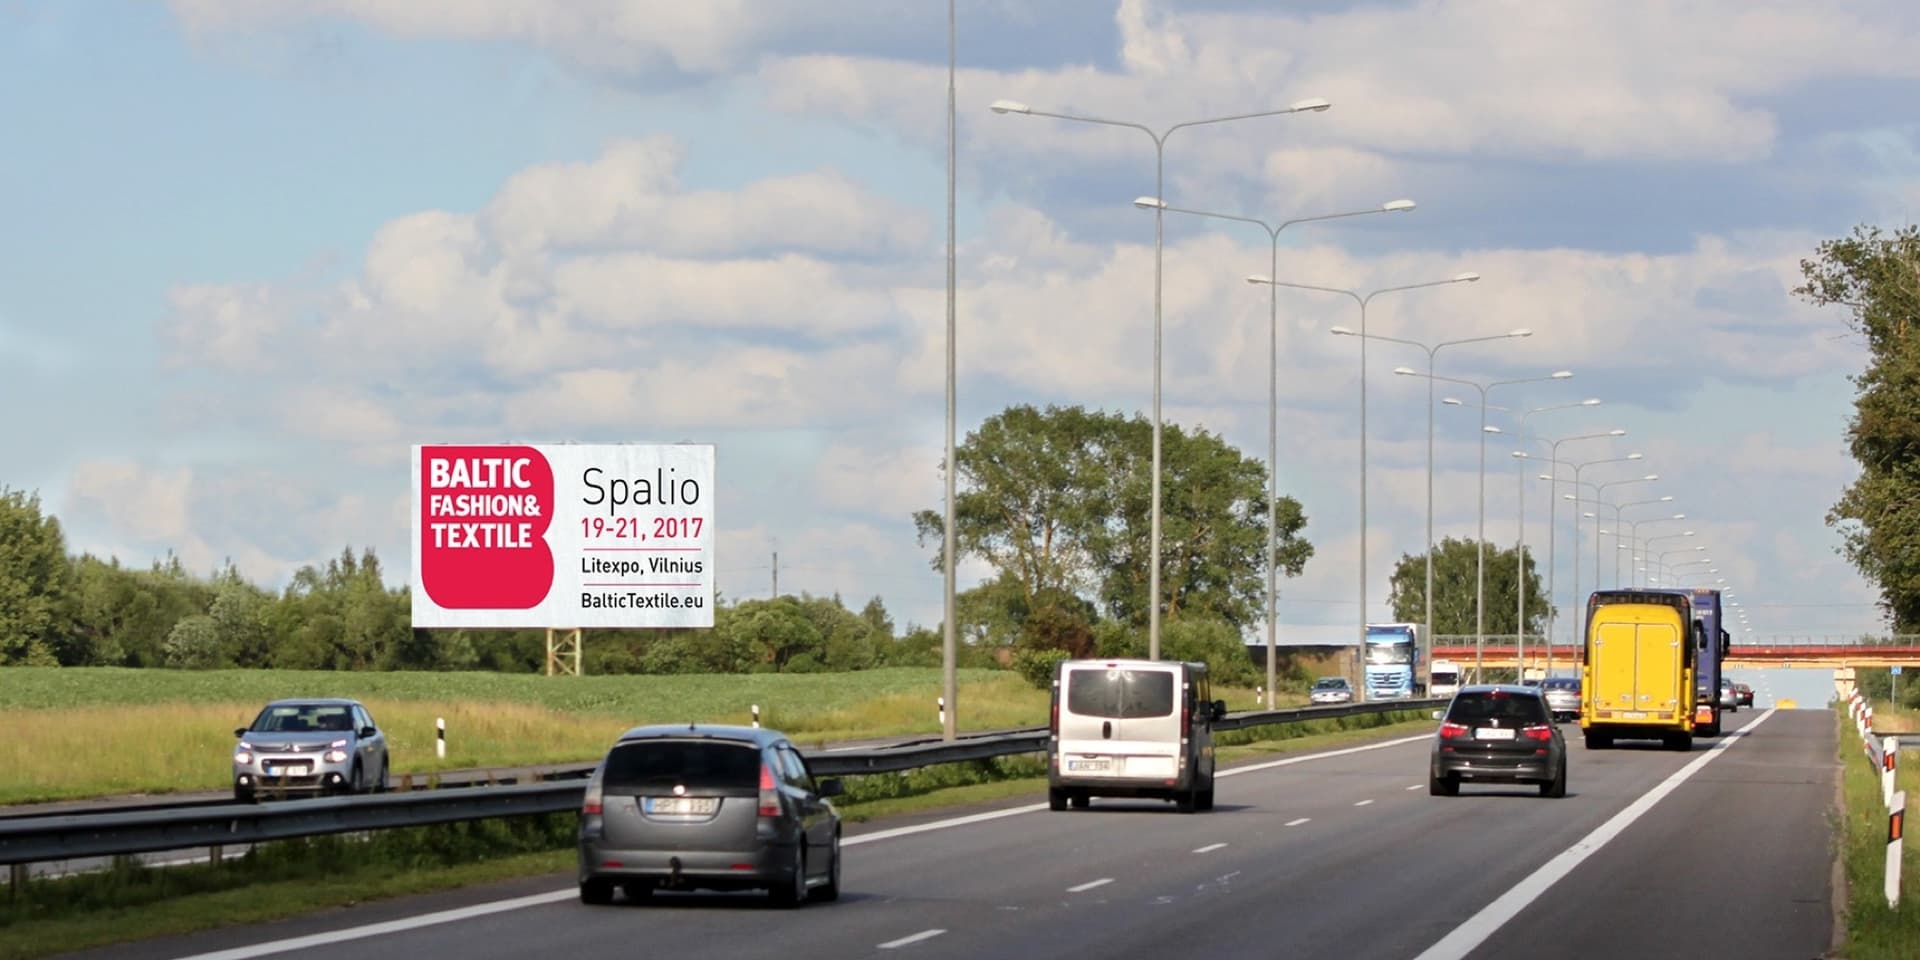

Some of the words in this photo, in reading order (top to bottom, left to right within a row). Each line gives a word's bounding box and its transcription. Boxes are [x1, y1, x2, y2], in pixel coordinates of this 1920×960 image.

[430, 458, 531, 489] BALTIC
[582, 467, 700, 516] Spalio
[430, 494, 541, 517] FASHION&
[431, 523, 533, 549] TEXTILE
[582, 518, 646, 541] 19-21,
[653, 518, 703, 538] 2017
[582, 557, 644, 577] Litexpo,
[648, 557, 703, 574] Vilnius
[581, 592, 704, 609] BalticTextile.eu
